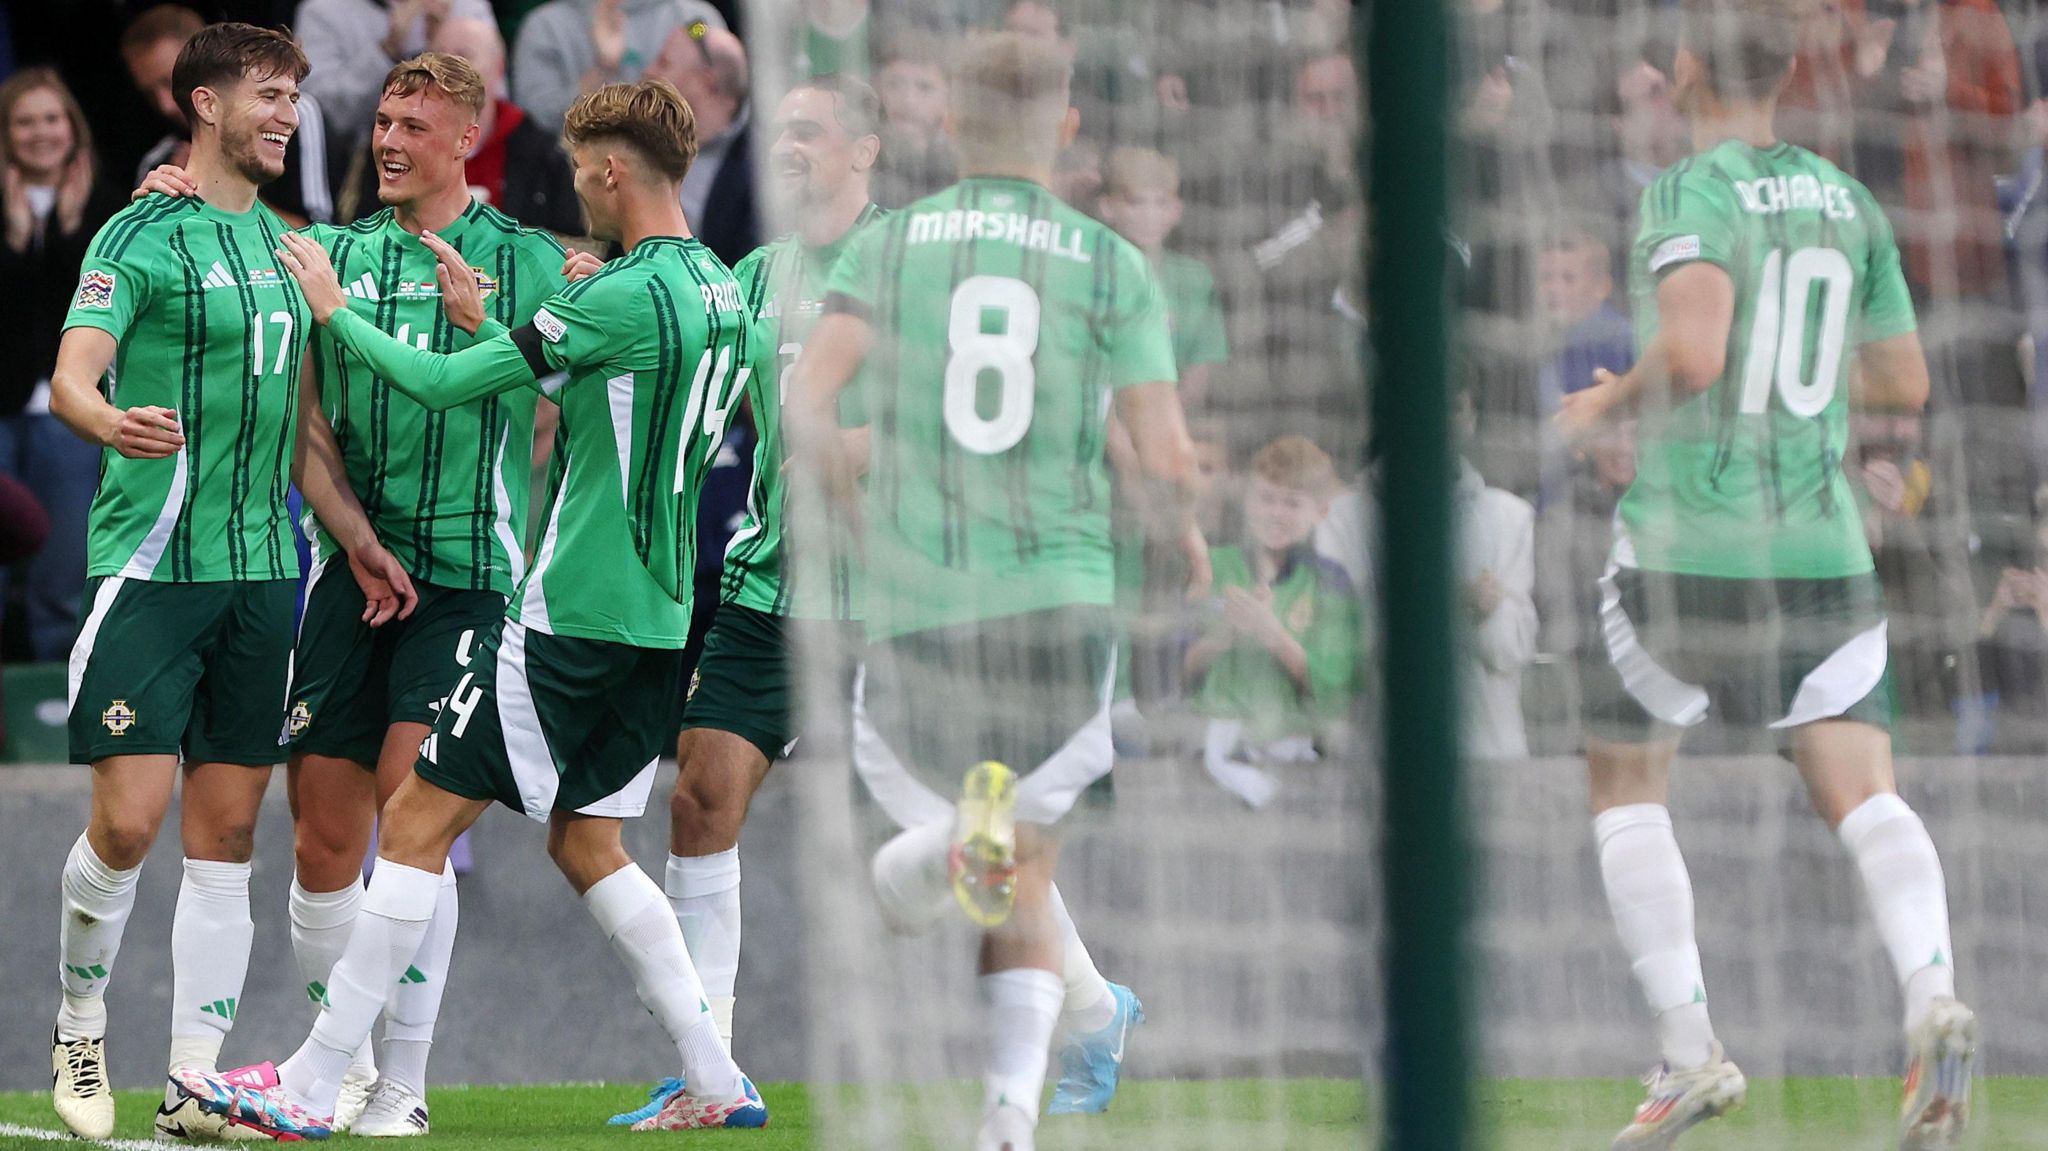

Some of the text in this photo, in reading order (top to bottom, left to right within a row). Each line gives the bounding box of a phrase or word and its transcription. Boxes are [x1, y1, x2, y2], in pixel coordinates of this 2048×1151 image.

[908, 209, 1091, 263] MARSHALL
[253, 311, 294, 376] 17
[943, 274, 1041, 455] 8
[1738, 247, 1854, 417] 10
[673, 344, 752, 496] 14
[434, 671, 484, 739] 4
